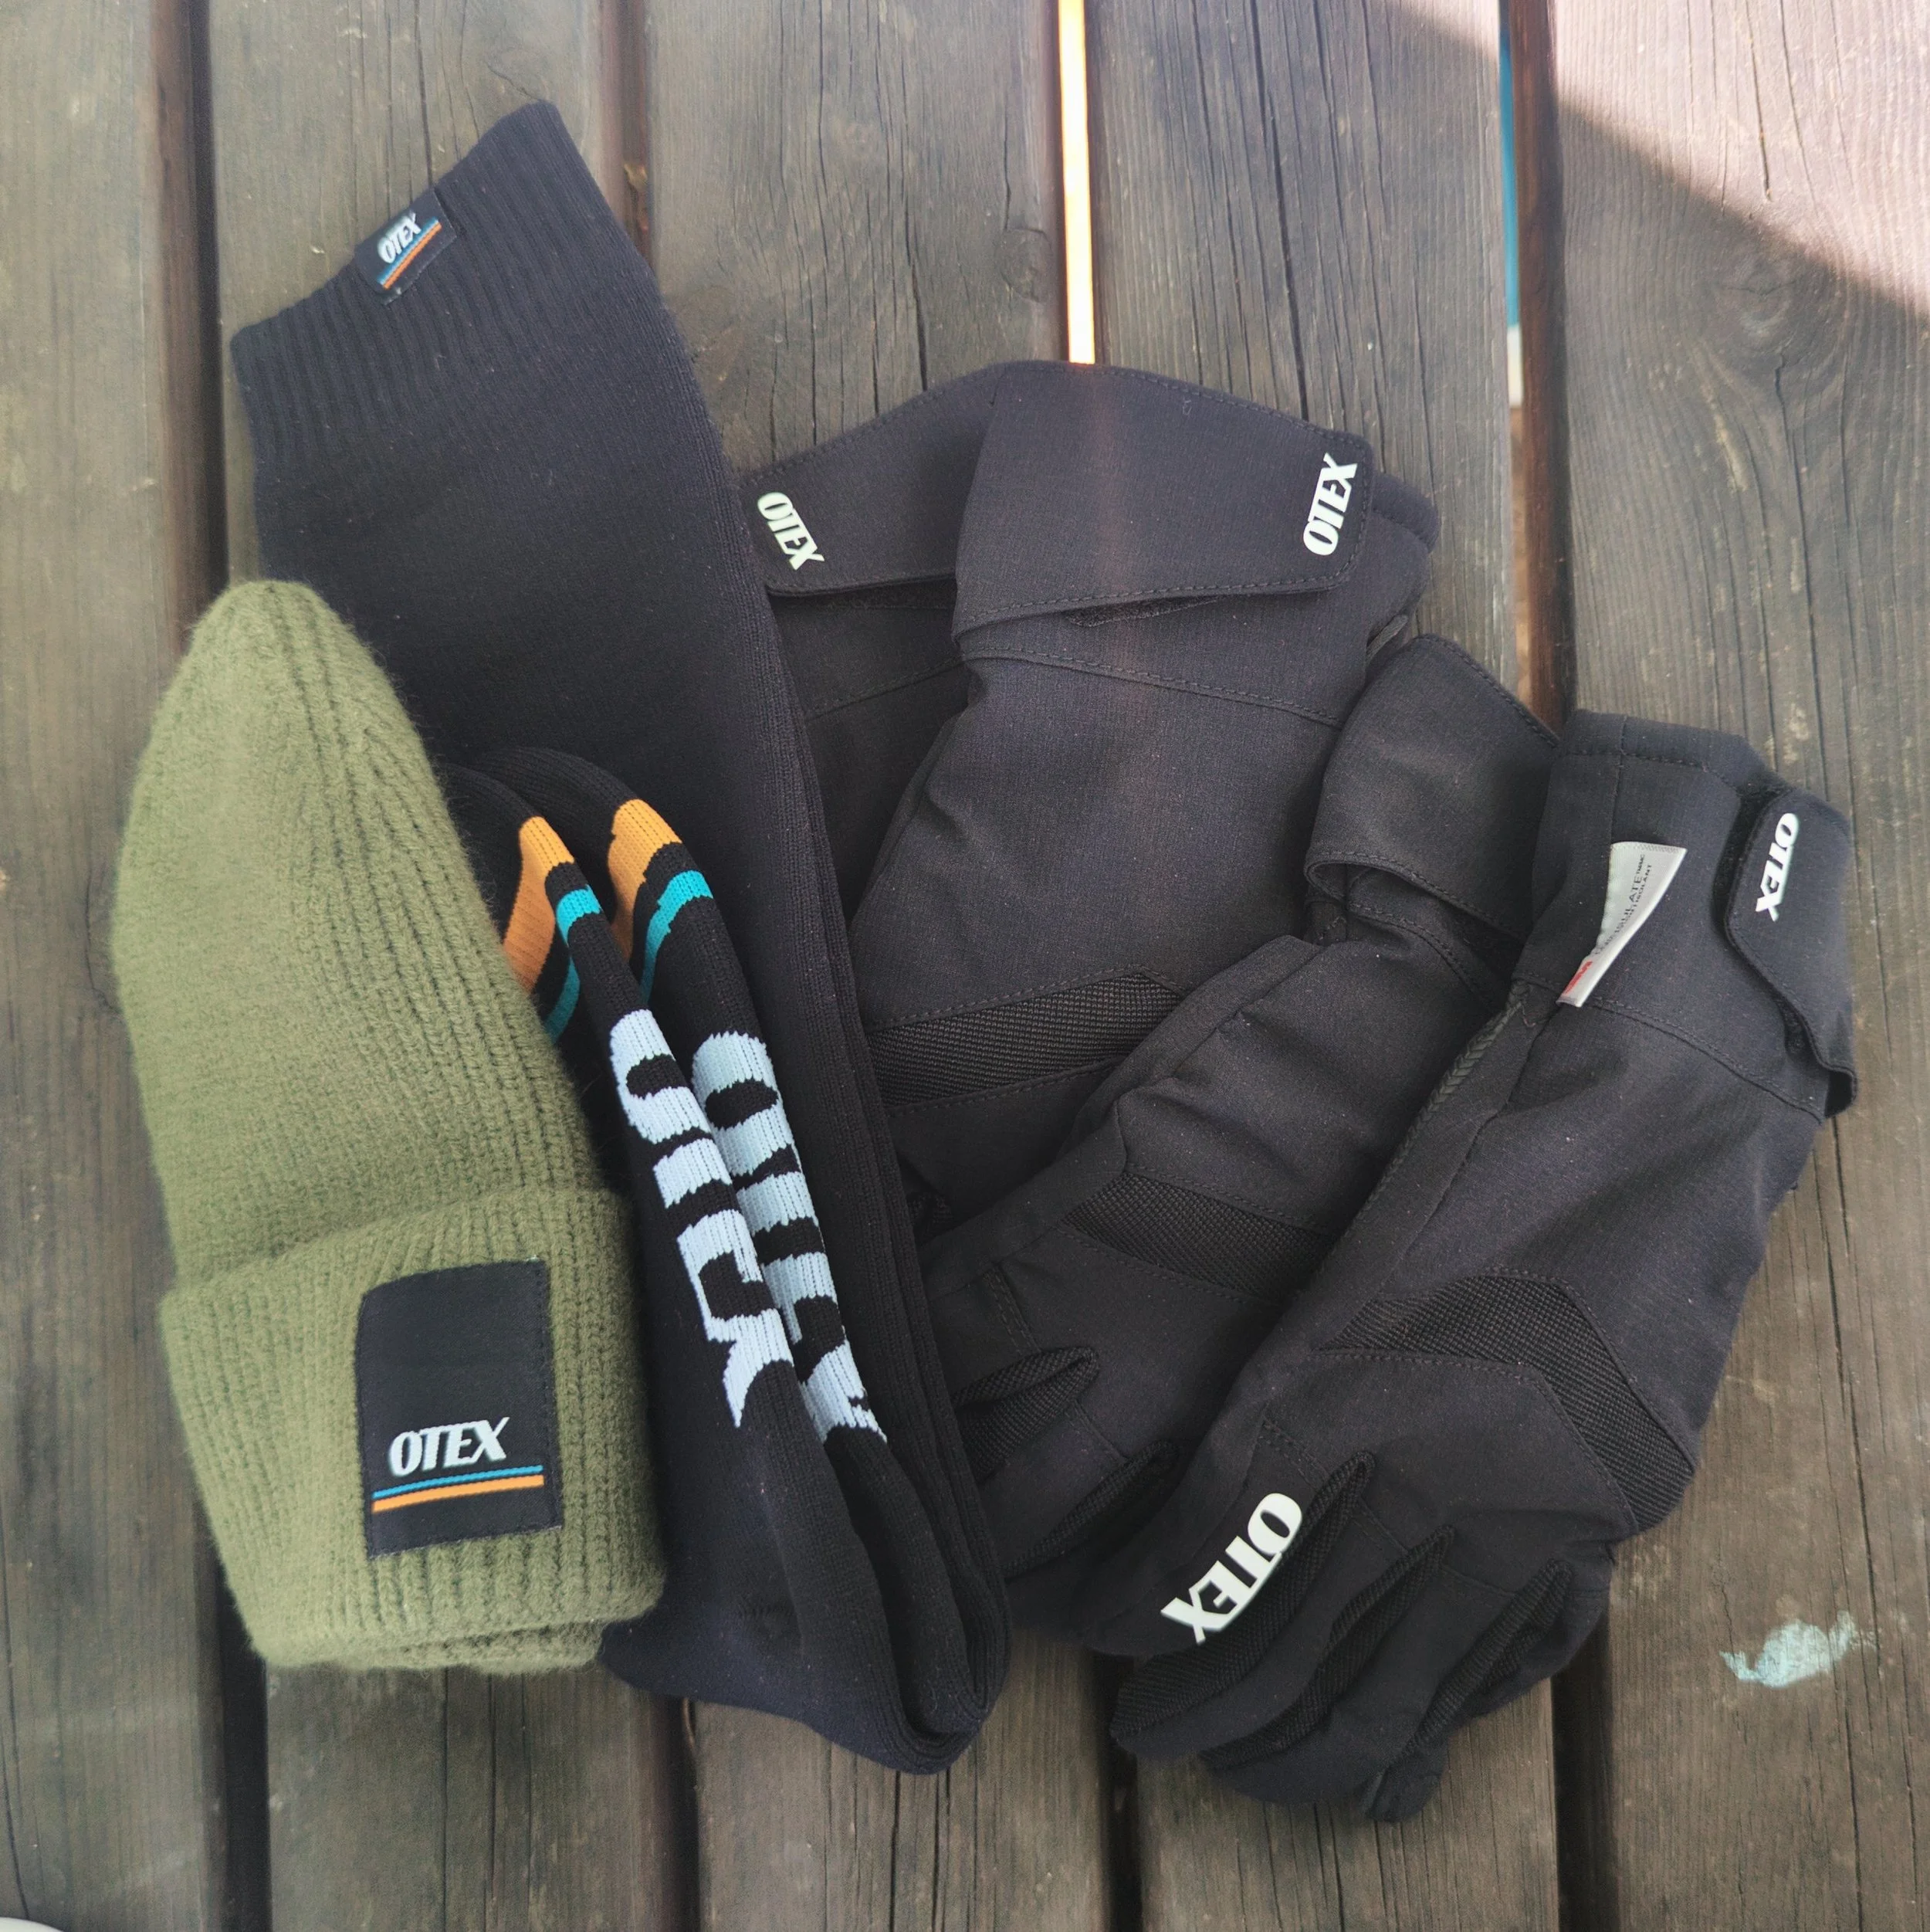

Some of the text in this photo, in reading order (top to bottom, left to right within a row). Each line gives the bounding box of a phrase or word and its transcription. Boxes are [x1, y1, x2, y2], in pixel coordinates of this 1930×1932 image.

[377, 211, 422, 263] OTEX
[757, 492, 825, 571] OTEX
[1303, 452, 1358, 556] OTEX
[1755, 812, 1800, 923] OTEX
[388, 1416, 510, 1477] OTEX
[1160, 1493, 1303, 1644] OTEX
